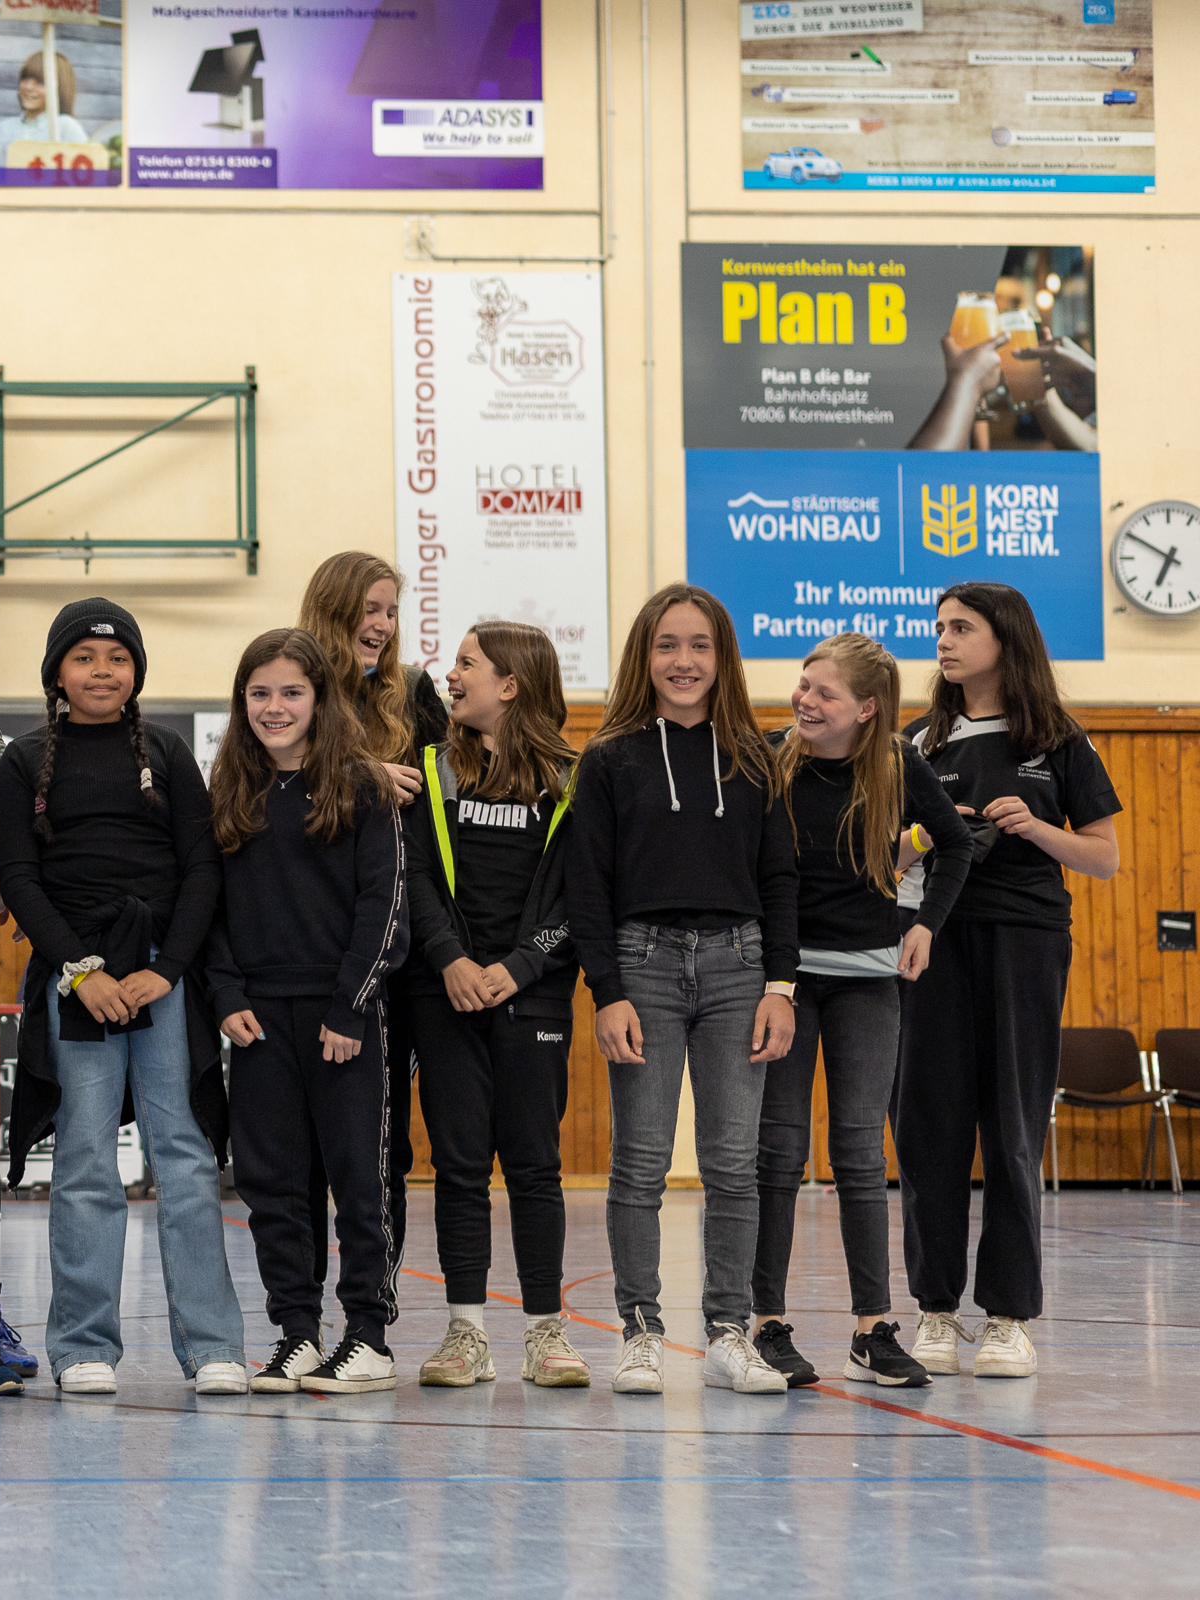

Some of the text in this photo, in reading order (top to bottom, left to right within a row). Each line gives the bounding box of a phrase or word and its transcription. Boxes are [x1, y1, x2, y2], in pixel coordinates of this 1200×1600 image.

[152, 5, 418, 20] Maßgeschneiderte Kassenhardware
[752, 4, 790, 19] ZEG
[1087, 5, 1107, 15] ZEG
[438, 108, 523, 127] ADASYS
[422, 132, 533, 147] We help to sell
[137, 155, 272, 168] Telefon 07154 8300-0
[137, 168, 234, 182] www.adasys.de
[722, 259, 906, 277] Kornwestheim hat ein
[722, 281, 908, 345] Plan B
[501, 347, 573, 367] Hasen
[407, 277, 438, 494] Gastronomie
[761, 368, 871, 384] Plan B die Bar
[764, 387, 869, 407] Bahnhofsplatz
[739, 406, 894, 424] 70806 Kornwestheim
[475, 464, 582, 488] HOTEL
[477, 489, 582, 514] DOMIZIL
[791, 493, 881, 513] STÄDTISCHE
[985, 484, 1059, 509] KORN
[727, 514, 881, 542] WOHNBAU
[985, 508, 1060, 533] WEST
[986, 532, 1060, 557] HEIM.
[794, 580, 833, 606] Ihr
[753, 613, 847, 637] Partner
[852, 612, 889, 638] für
[458, 799, 528, 829] PUMA
[537, 1031, 563, 1043] Kempa
